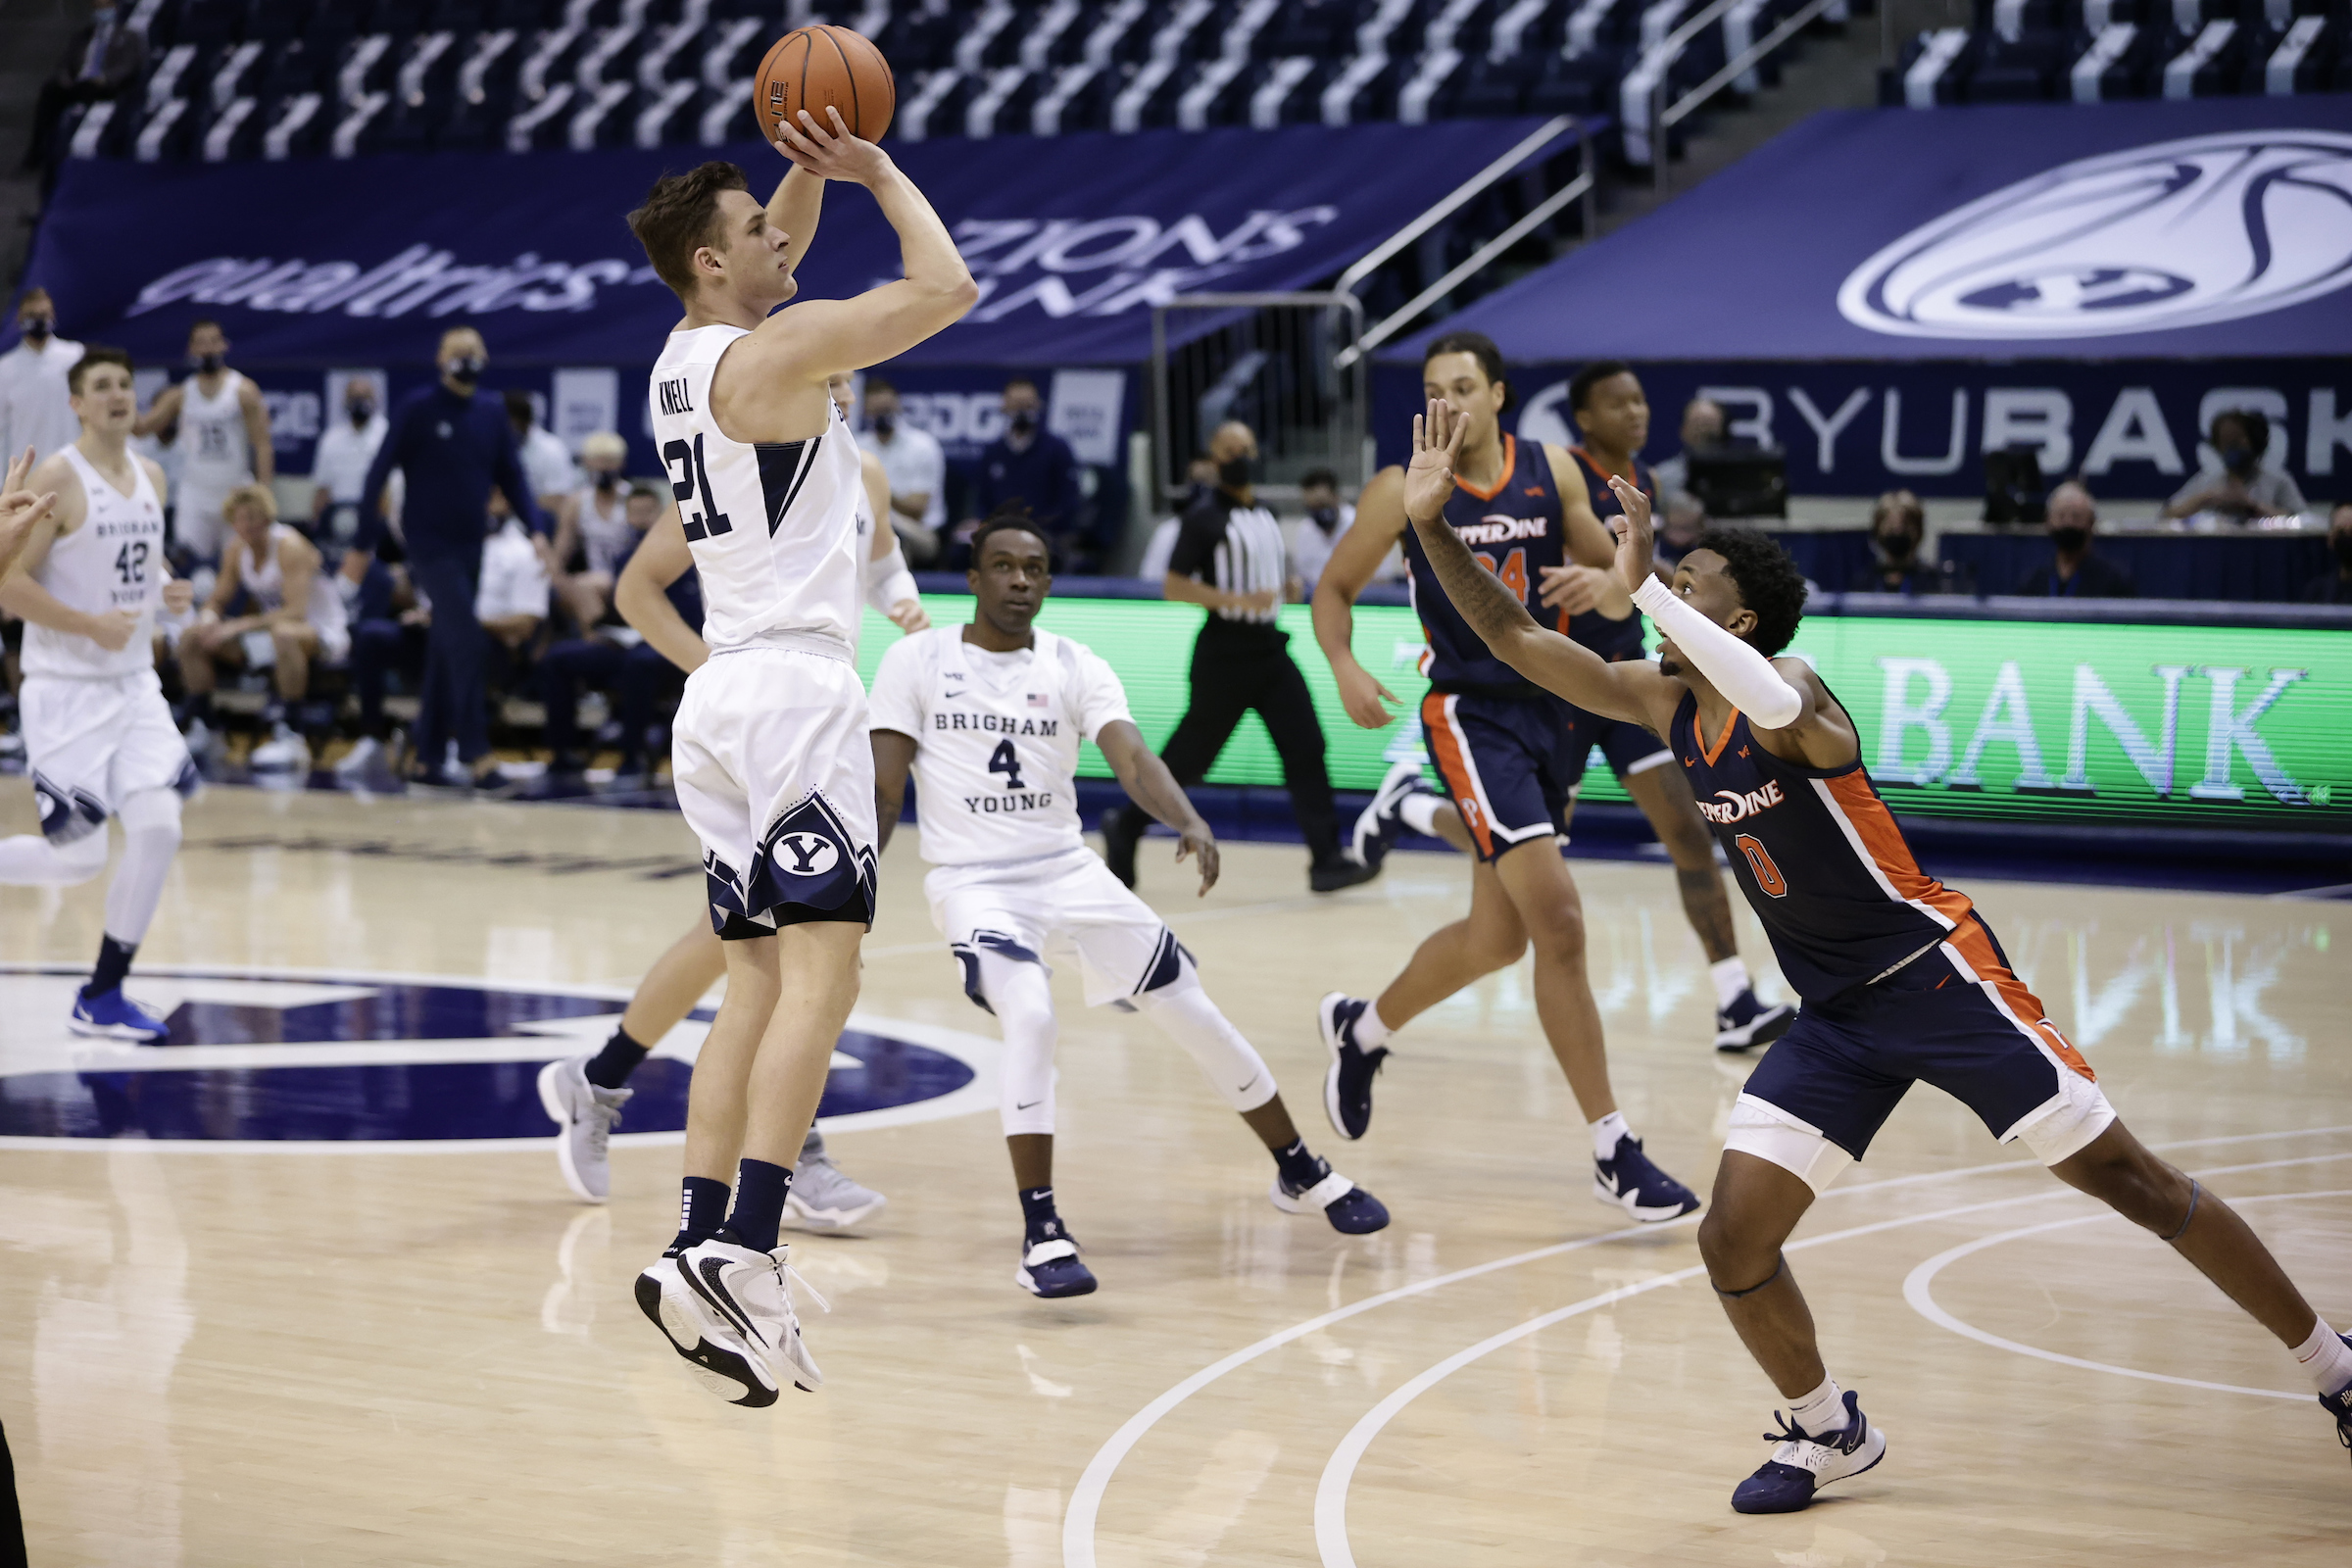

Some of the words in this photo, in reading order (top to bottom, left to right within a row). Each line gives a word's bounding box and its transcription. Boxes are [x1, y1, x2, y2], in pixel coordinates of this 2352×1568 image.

[953, 204, 1339, 275] ZIONS
[659, 377, 694, 416] KNELL
[663, 432, 733, 542] 21
[1452, 514, 1547, 545] PPERDINE
[116, 541, 149, 583] 42
[935, 713, 1058, 736] BRIGHAM
[1872, 655, 2314, 806] BANK
[988, 737, 1025, 790] 4
[964, 793, 1053, 813] YOUNG
[781, 835, 831, 873] Y
[1735, 833, 1788, 899] 0
